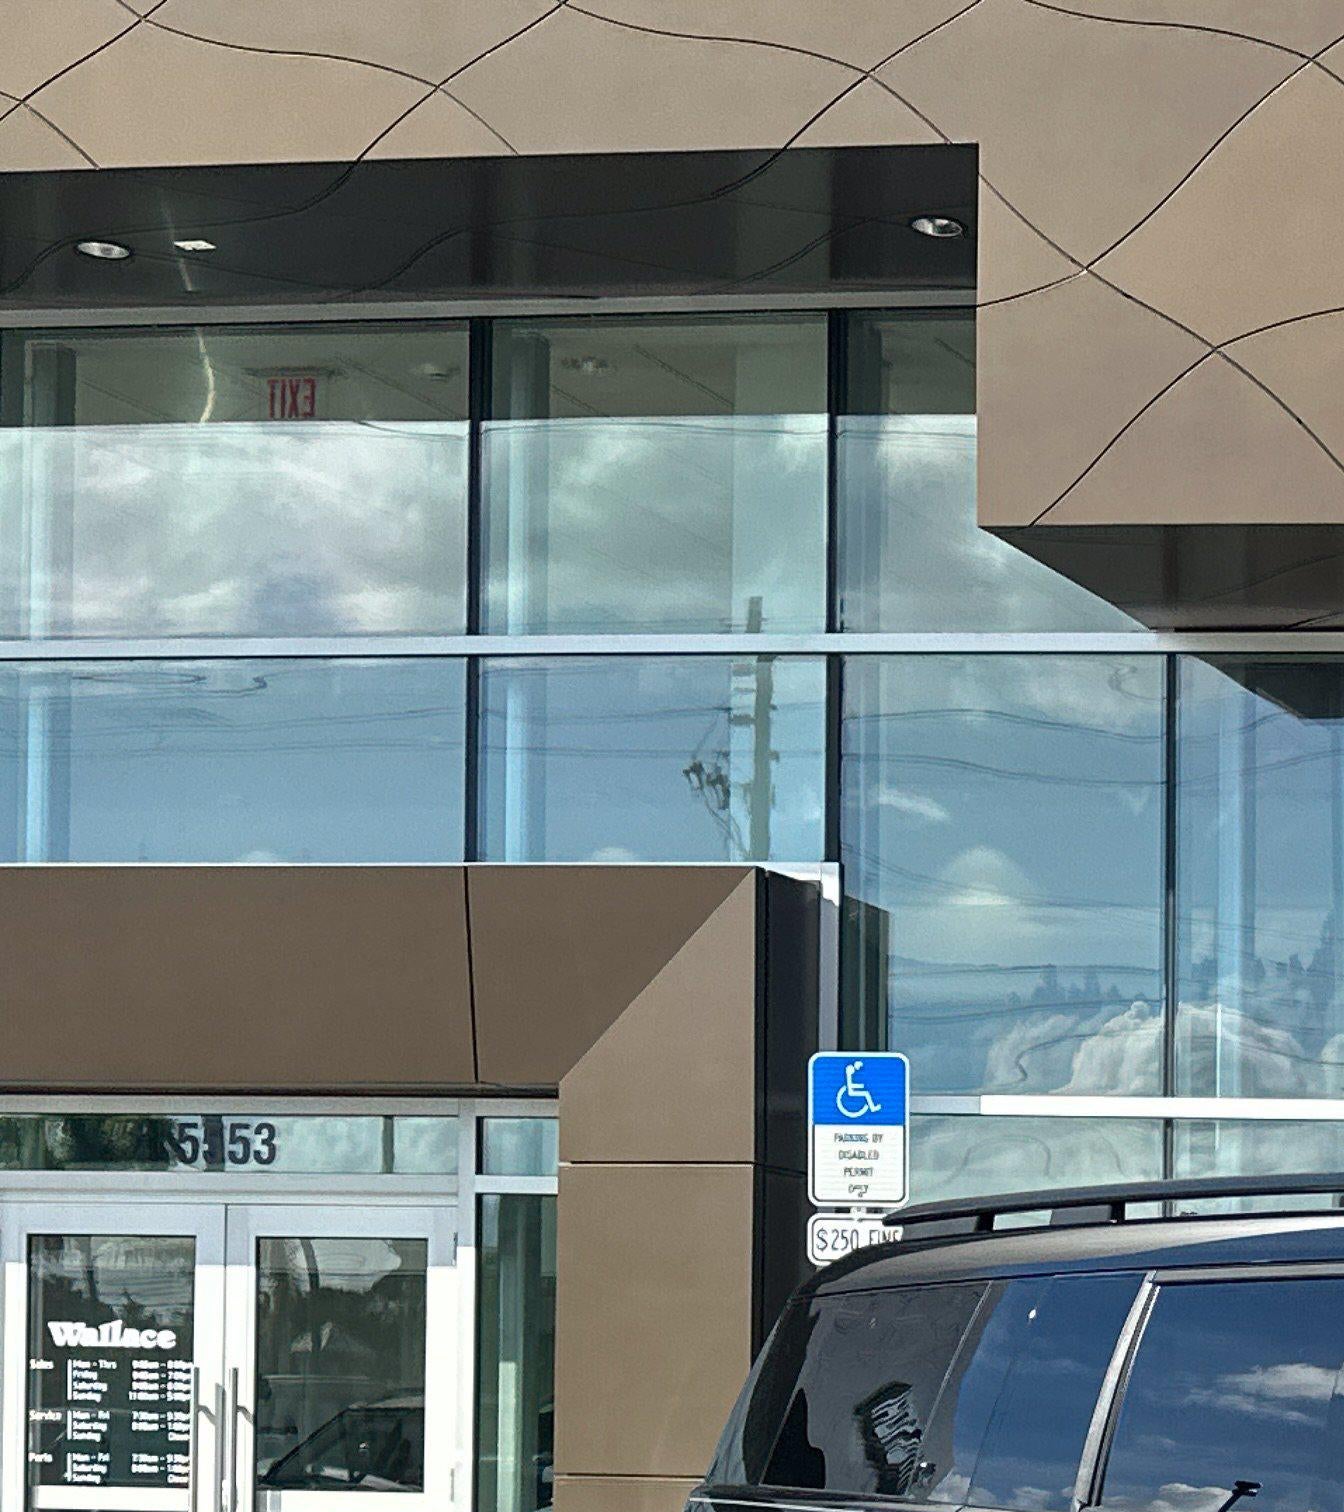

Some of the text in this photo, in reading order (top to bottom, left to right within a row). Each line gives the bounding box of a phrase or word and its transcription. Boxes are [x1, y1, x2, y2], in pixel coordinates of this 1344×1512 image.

[177, 1122, 276, 1164] 553
[816, 1228, 860, 1251] $250
[47, 1319, 177, 1349] Wallace
